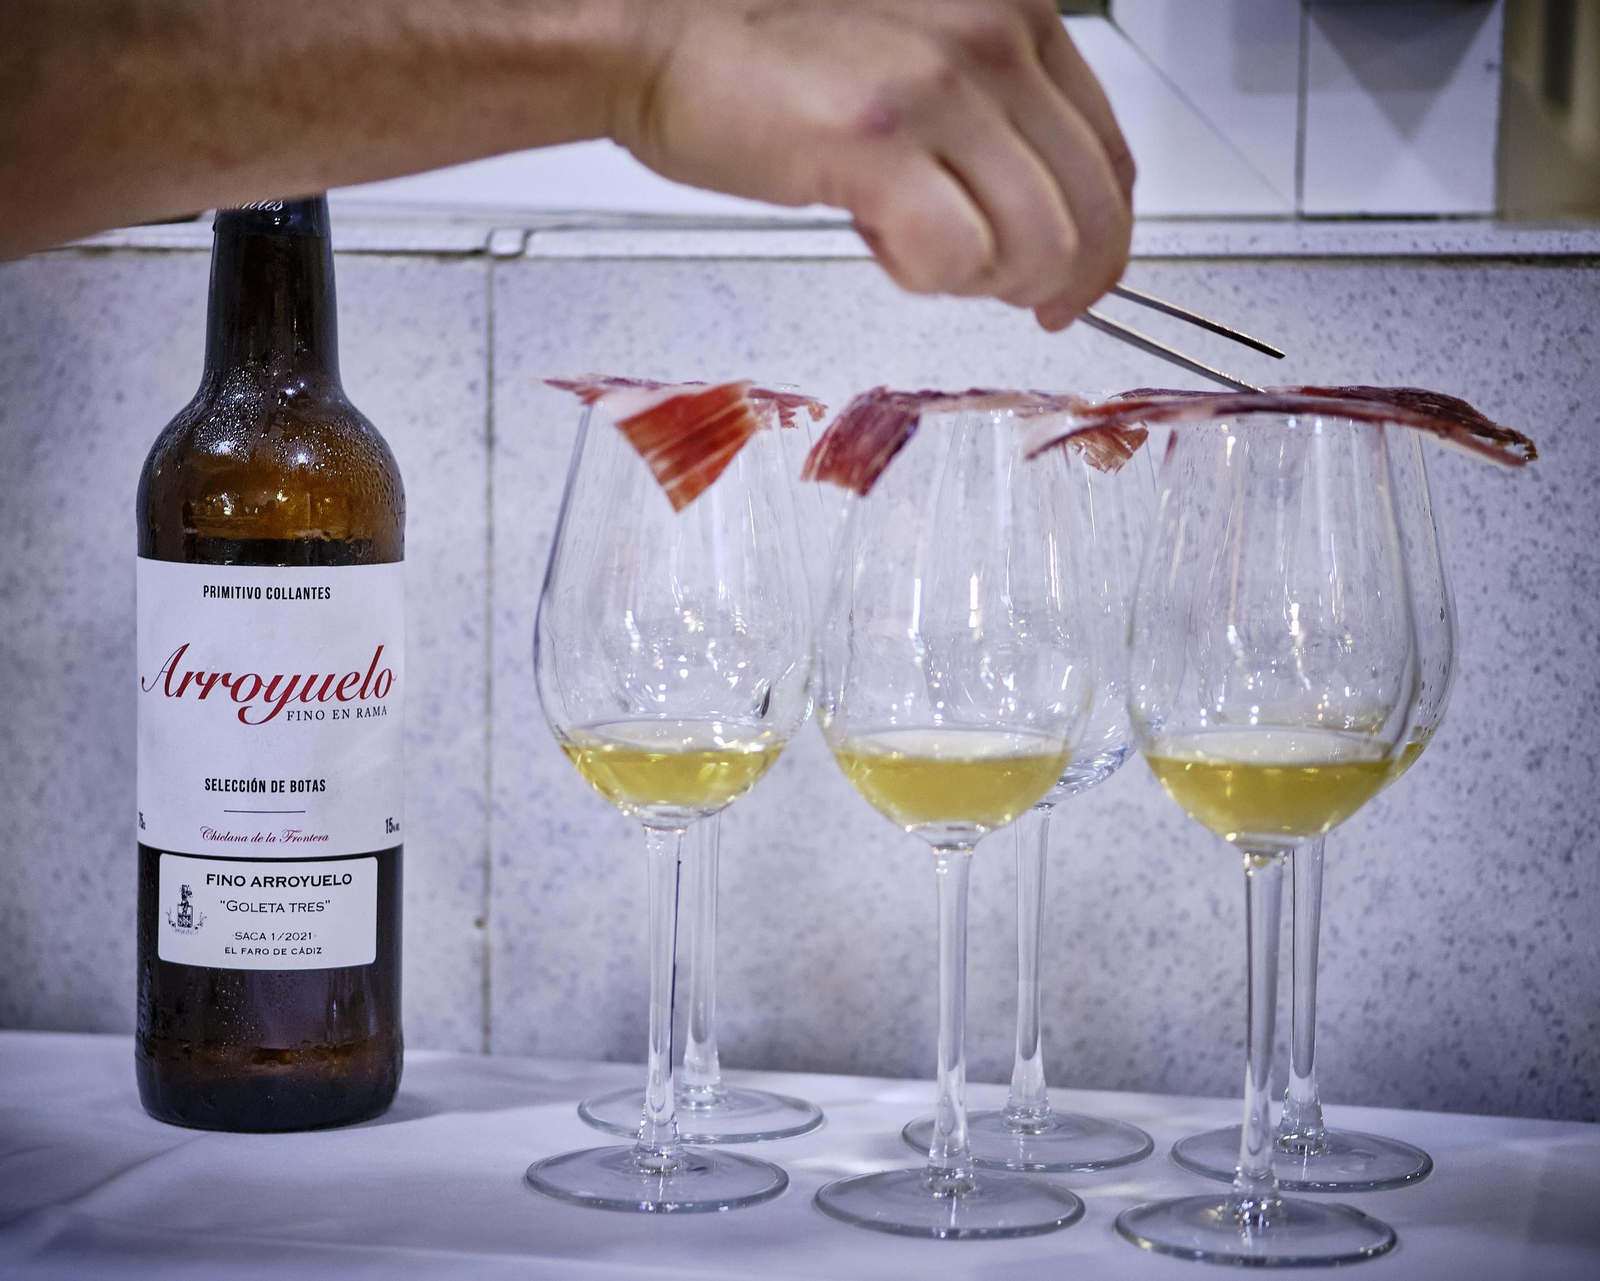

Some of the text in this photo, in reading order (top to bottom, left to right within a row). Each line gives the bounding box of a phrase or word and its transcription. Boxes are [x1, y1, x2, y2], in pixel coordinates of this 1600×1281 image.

[203, 585, 332, 600] PRIMITIVO COLLANTES
[141, 642, 398, 726] Arroyuelo
[286, 705, 388, 722] FINO EN RAMA
[204, 777, 326, 793] SELECCIÓN DE BOTAS
[199, 825, 330, 844] Chiclana de la Frontera
[206, 873, 353, 888] FINO ARROYUELO
[224, 946, 323, 955] EL FARO DE CÁDIZ
